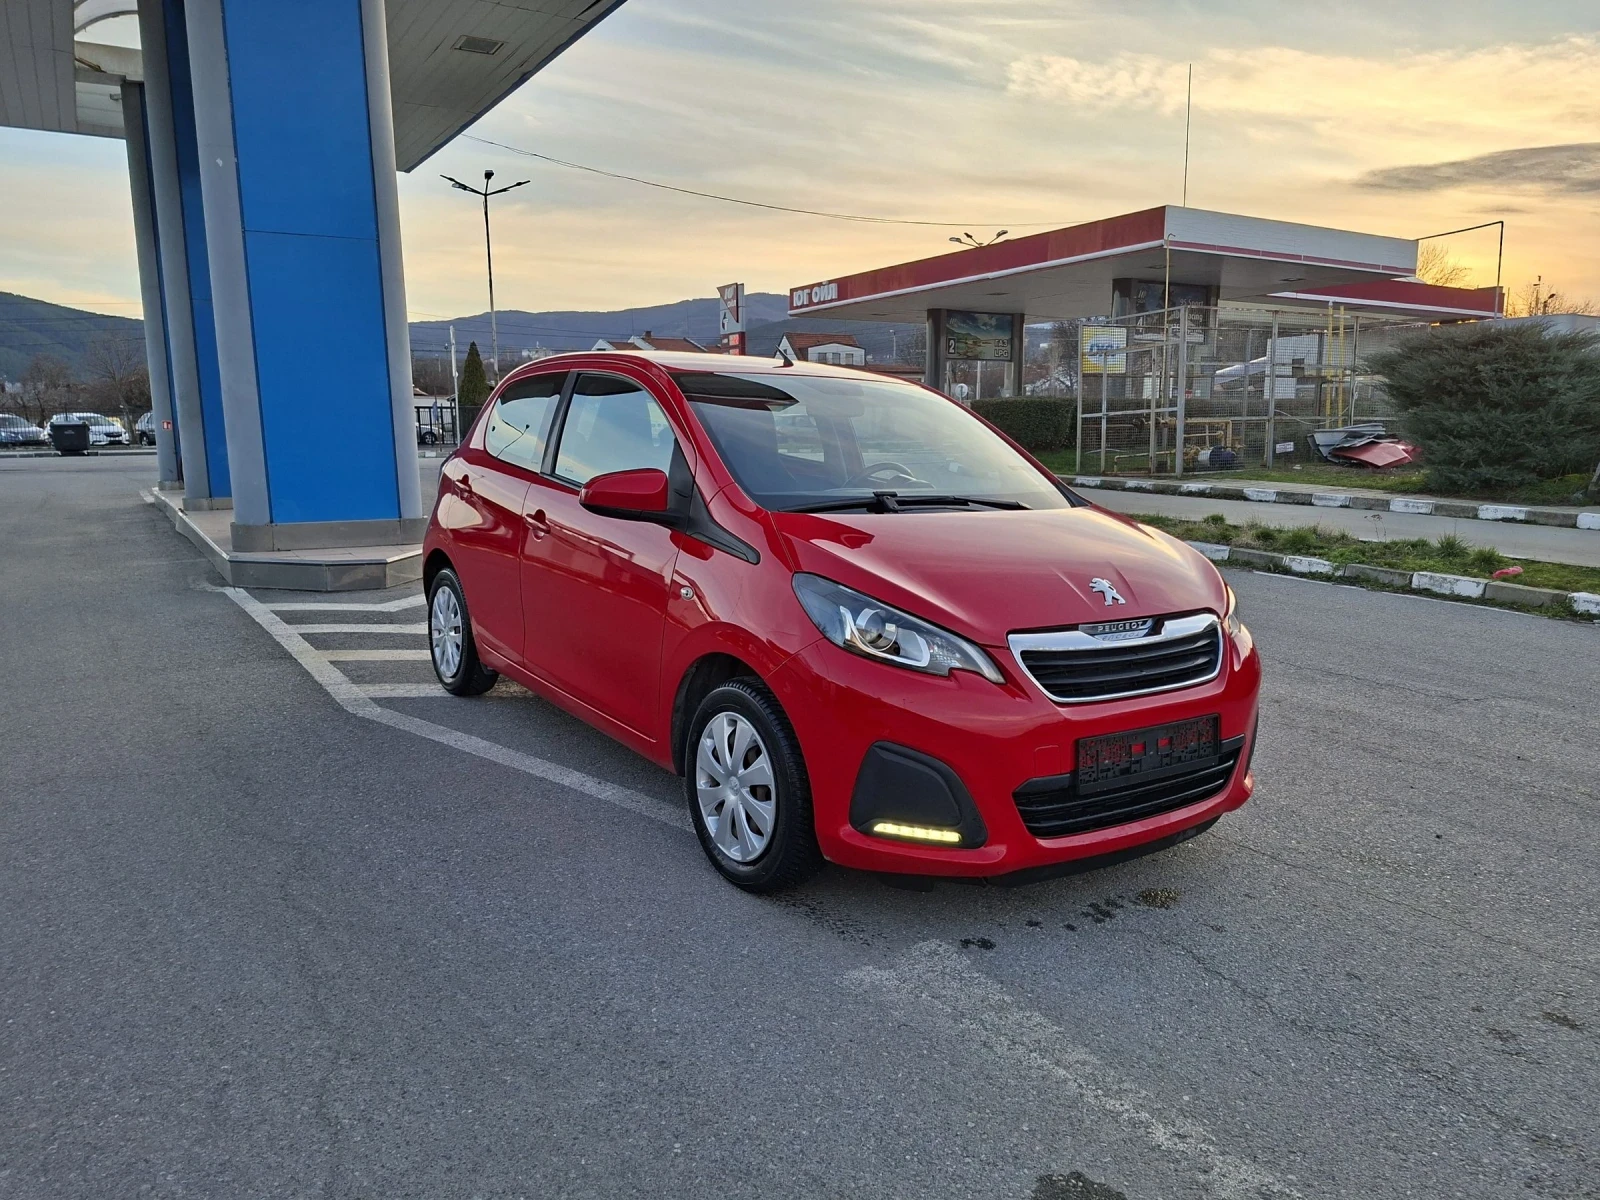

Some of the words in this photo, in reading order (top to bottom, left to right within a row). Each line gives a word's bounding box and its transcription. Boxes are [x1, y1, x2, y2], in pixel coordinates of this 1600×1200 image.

[793, 289, 811, 307] ЮГ
[812, 280, 838, 303] ОЙЛ
[949, 340, 955, 353] 2
[994, 349, 1009, 357] LPG
[1097, 621, 1144, 633] PEUGEOT
